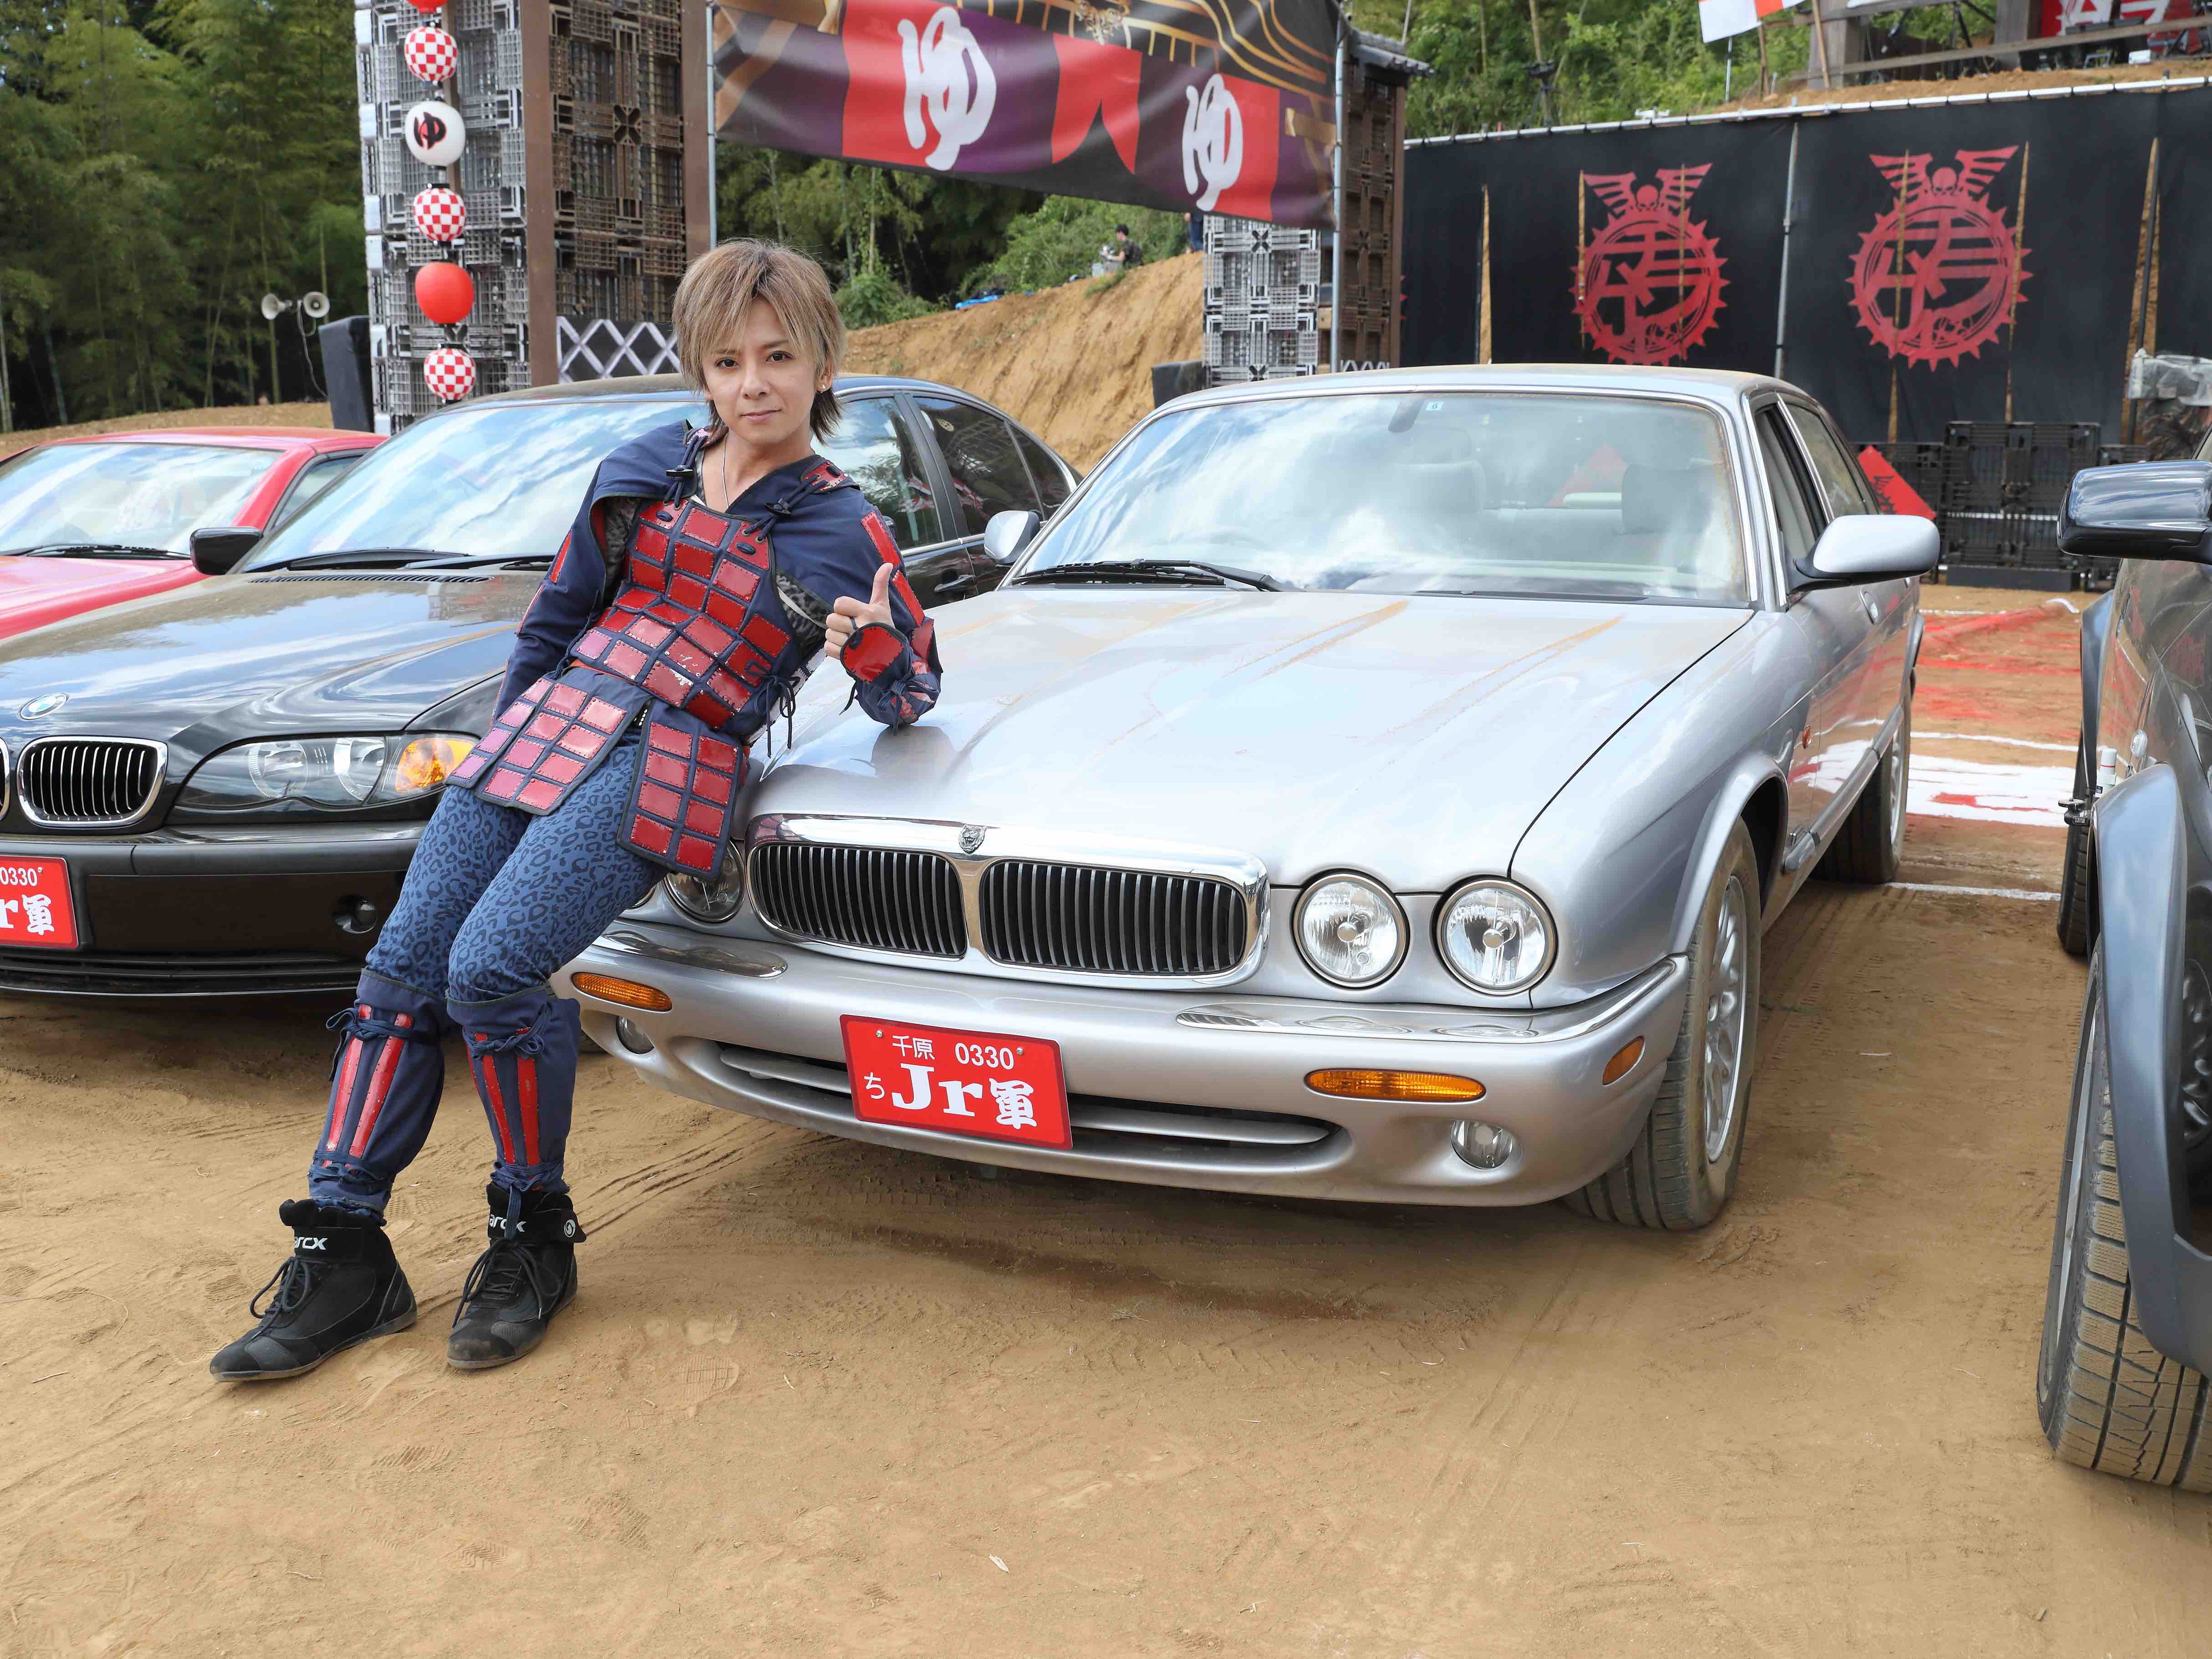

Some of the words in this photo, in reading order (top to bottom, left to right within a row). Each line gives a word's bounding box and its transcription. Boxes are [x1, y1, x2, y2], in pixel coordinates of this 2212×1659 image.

[0, 867, 38, 886] 0330
[892, 1035, 935, 1060] 千原
[955, 1043, 1014, 1070] 0330
[864, 1072, 885, 1100] ち
